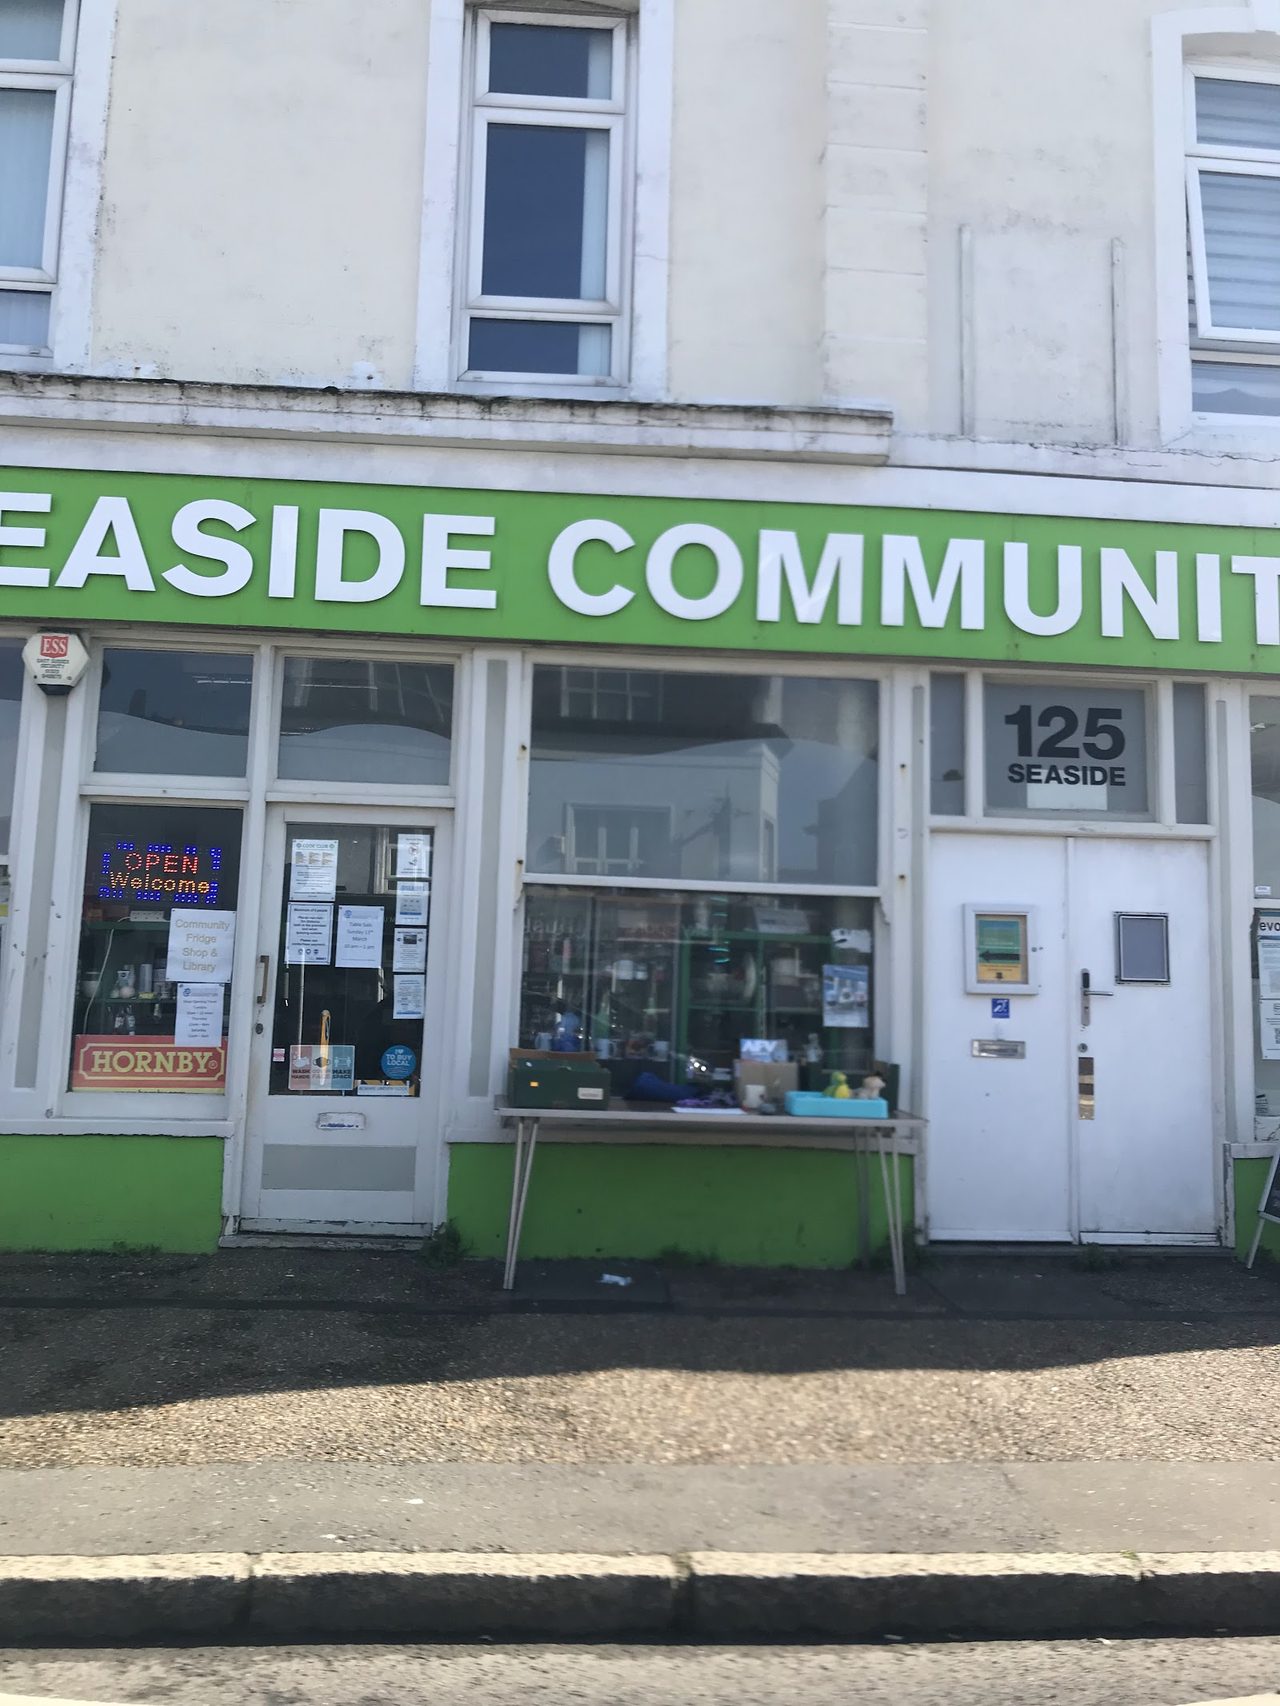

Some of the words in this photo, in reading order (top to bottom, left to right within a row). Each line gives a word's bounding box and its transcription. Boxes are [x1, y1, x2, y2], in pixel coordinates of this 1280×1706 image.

[0, 492, 497, 609] EASIDE
[548, 519, 1280, 646] COMMUNIT
[42, 639, 67, 654] ESS
[1004, 705, 1126, 760] 125
[1008, 763, 1126, 787] SEASIDE
[125, 852, 199, 874] OPEN
[110, 871, 210, 893] Welcome
[175, 919, 230, 931] Community
[186, 933, 217, 944] Fridge
[182, 948, 208, 958] Shop
[210, 949, 217, 957] &
[183, 961, 216, 972] Library
[91, 1051, 213, 1073] HORNBY
